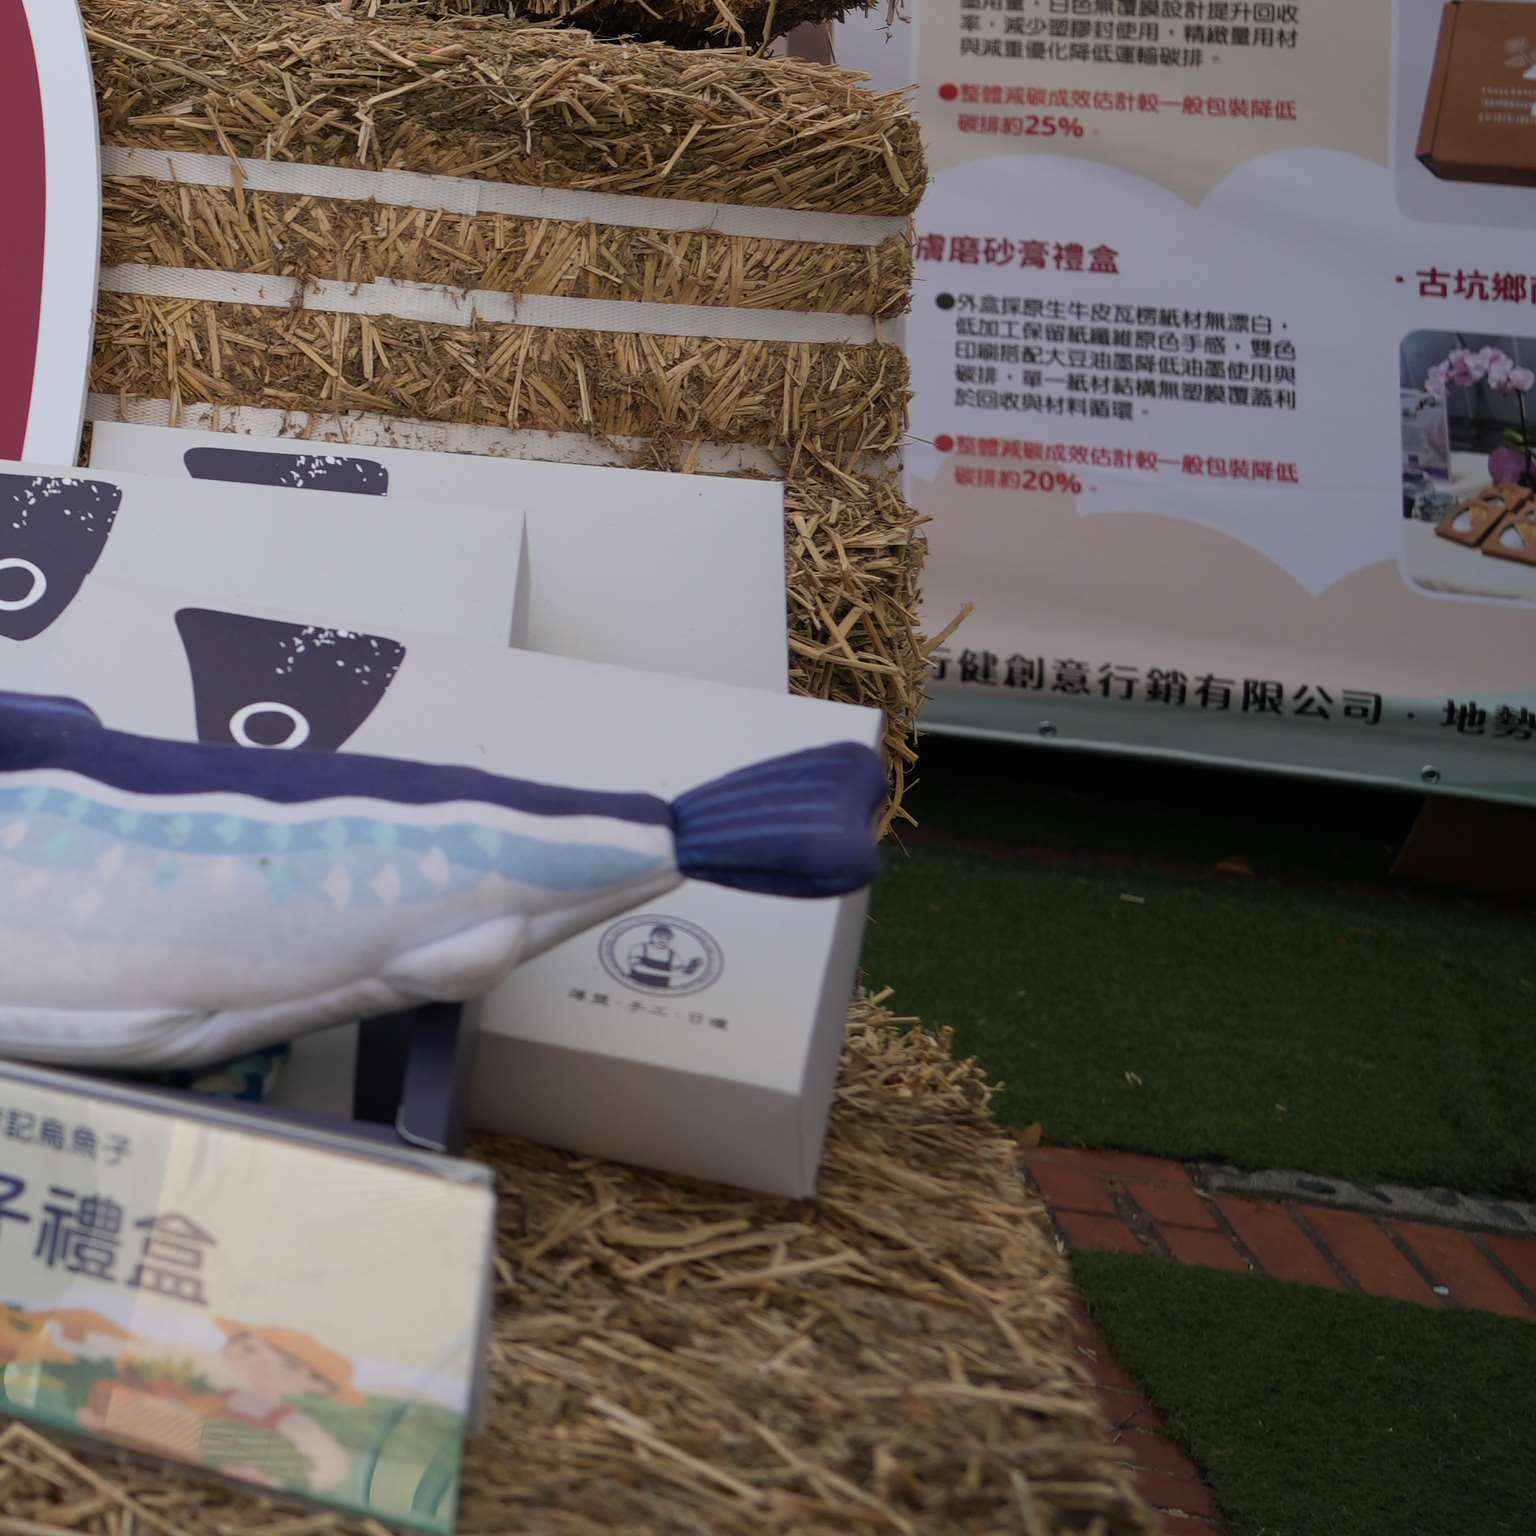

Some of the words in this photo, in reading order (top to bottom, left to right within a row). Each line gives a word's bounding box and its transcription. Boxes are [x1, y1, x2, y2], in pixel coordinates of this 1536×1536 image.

[916, 234, 1120, 275] 膚磨砂膏禮盒
[1416, 267, 1536, 304] 古坑鄉
